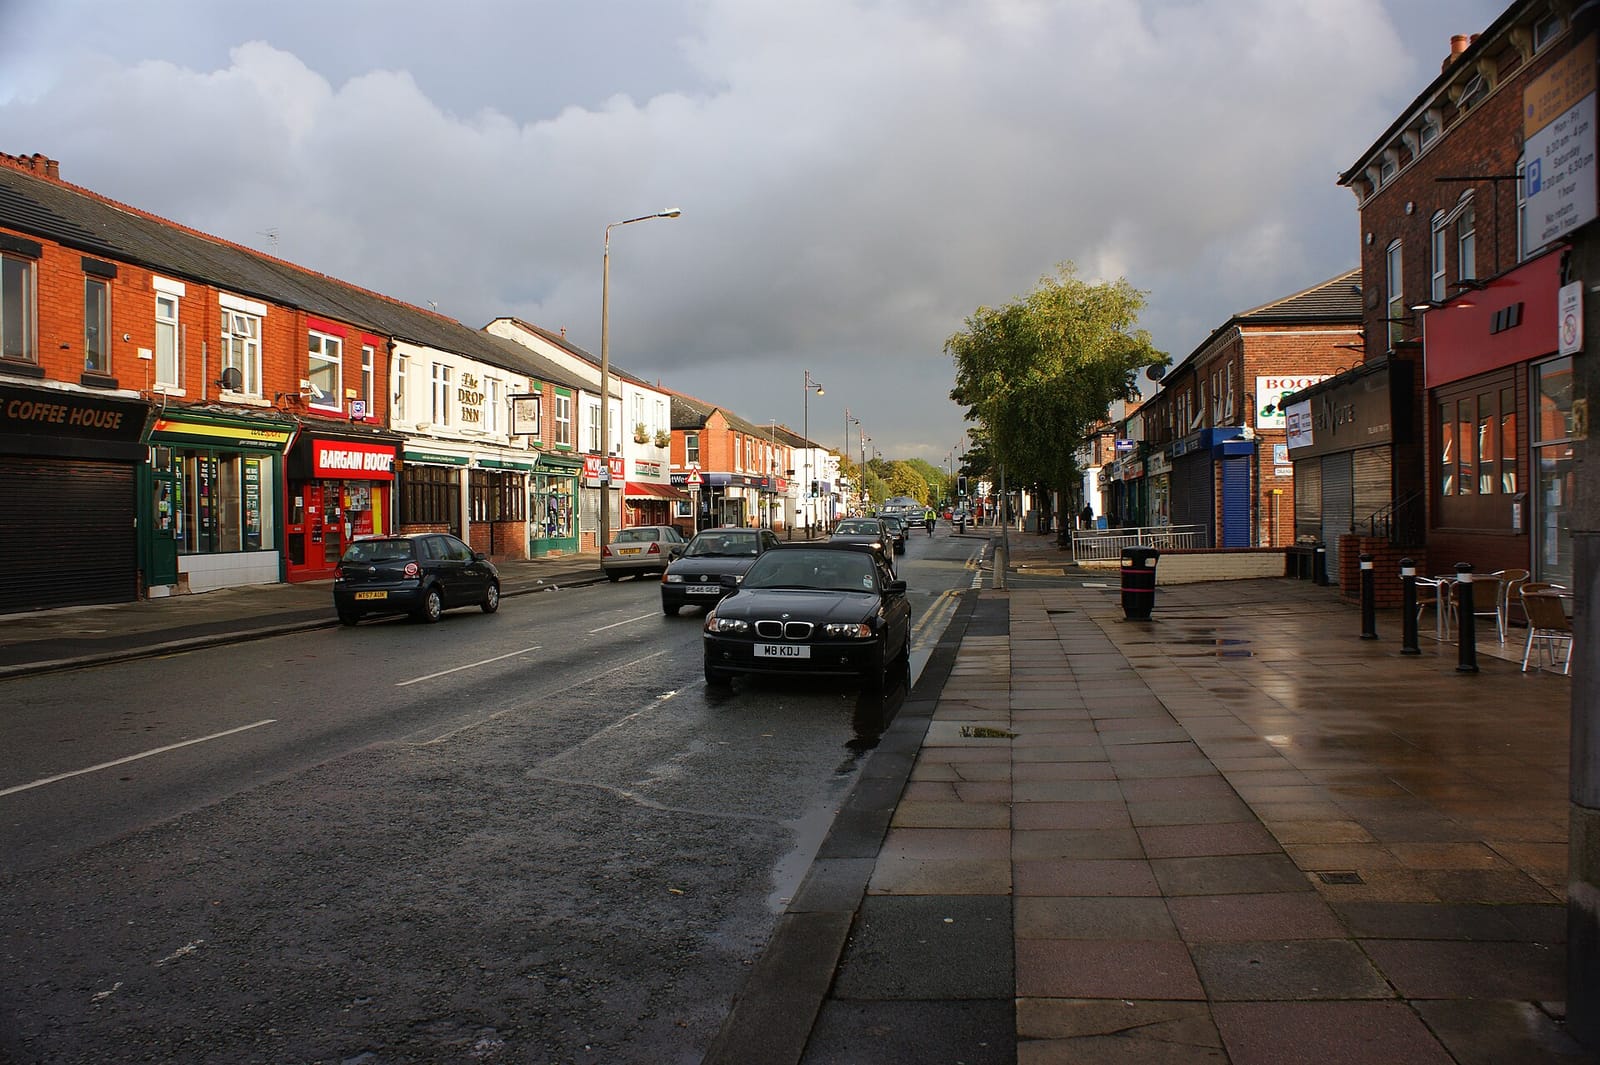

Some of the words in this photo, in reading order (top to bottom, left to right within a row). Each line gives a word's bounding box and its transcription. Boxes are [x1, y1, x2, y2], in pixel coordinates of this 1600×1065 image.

[1529, 162, 1539, 193] P
[461, 372, 478, 389] The
[458, 388, 484, 406] DROP
[7, 400, 68, 423] COFFEE
[69, 407, 124, 430] HOUSE
[461, 406, 479, 423] INN
[319, 449, 363, 470] BARGAIN
[764, 645, 777, 656] M8
[779, 646, 800, 657] KDJ
